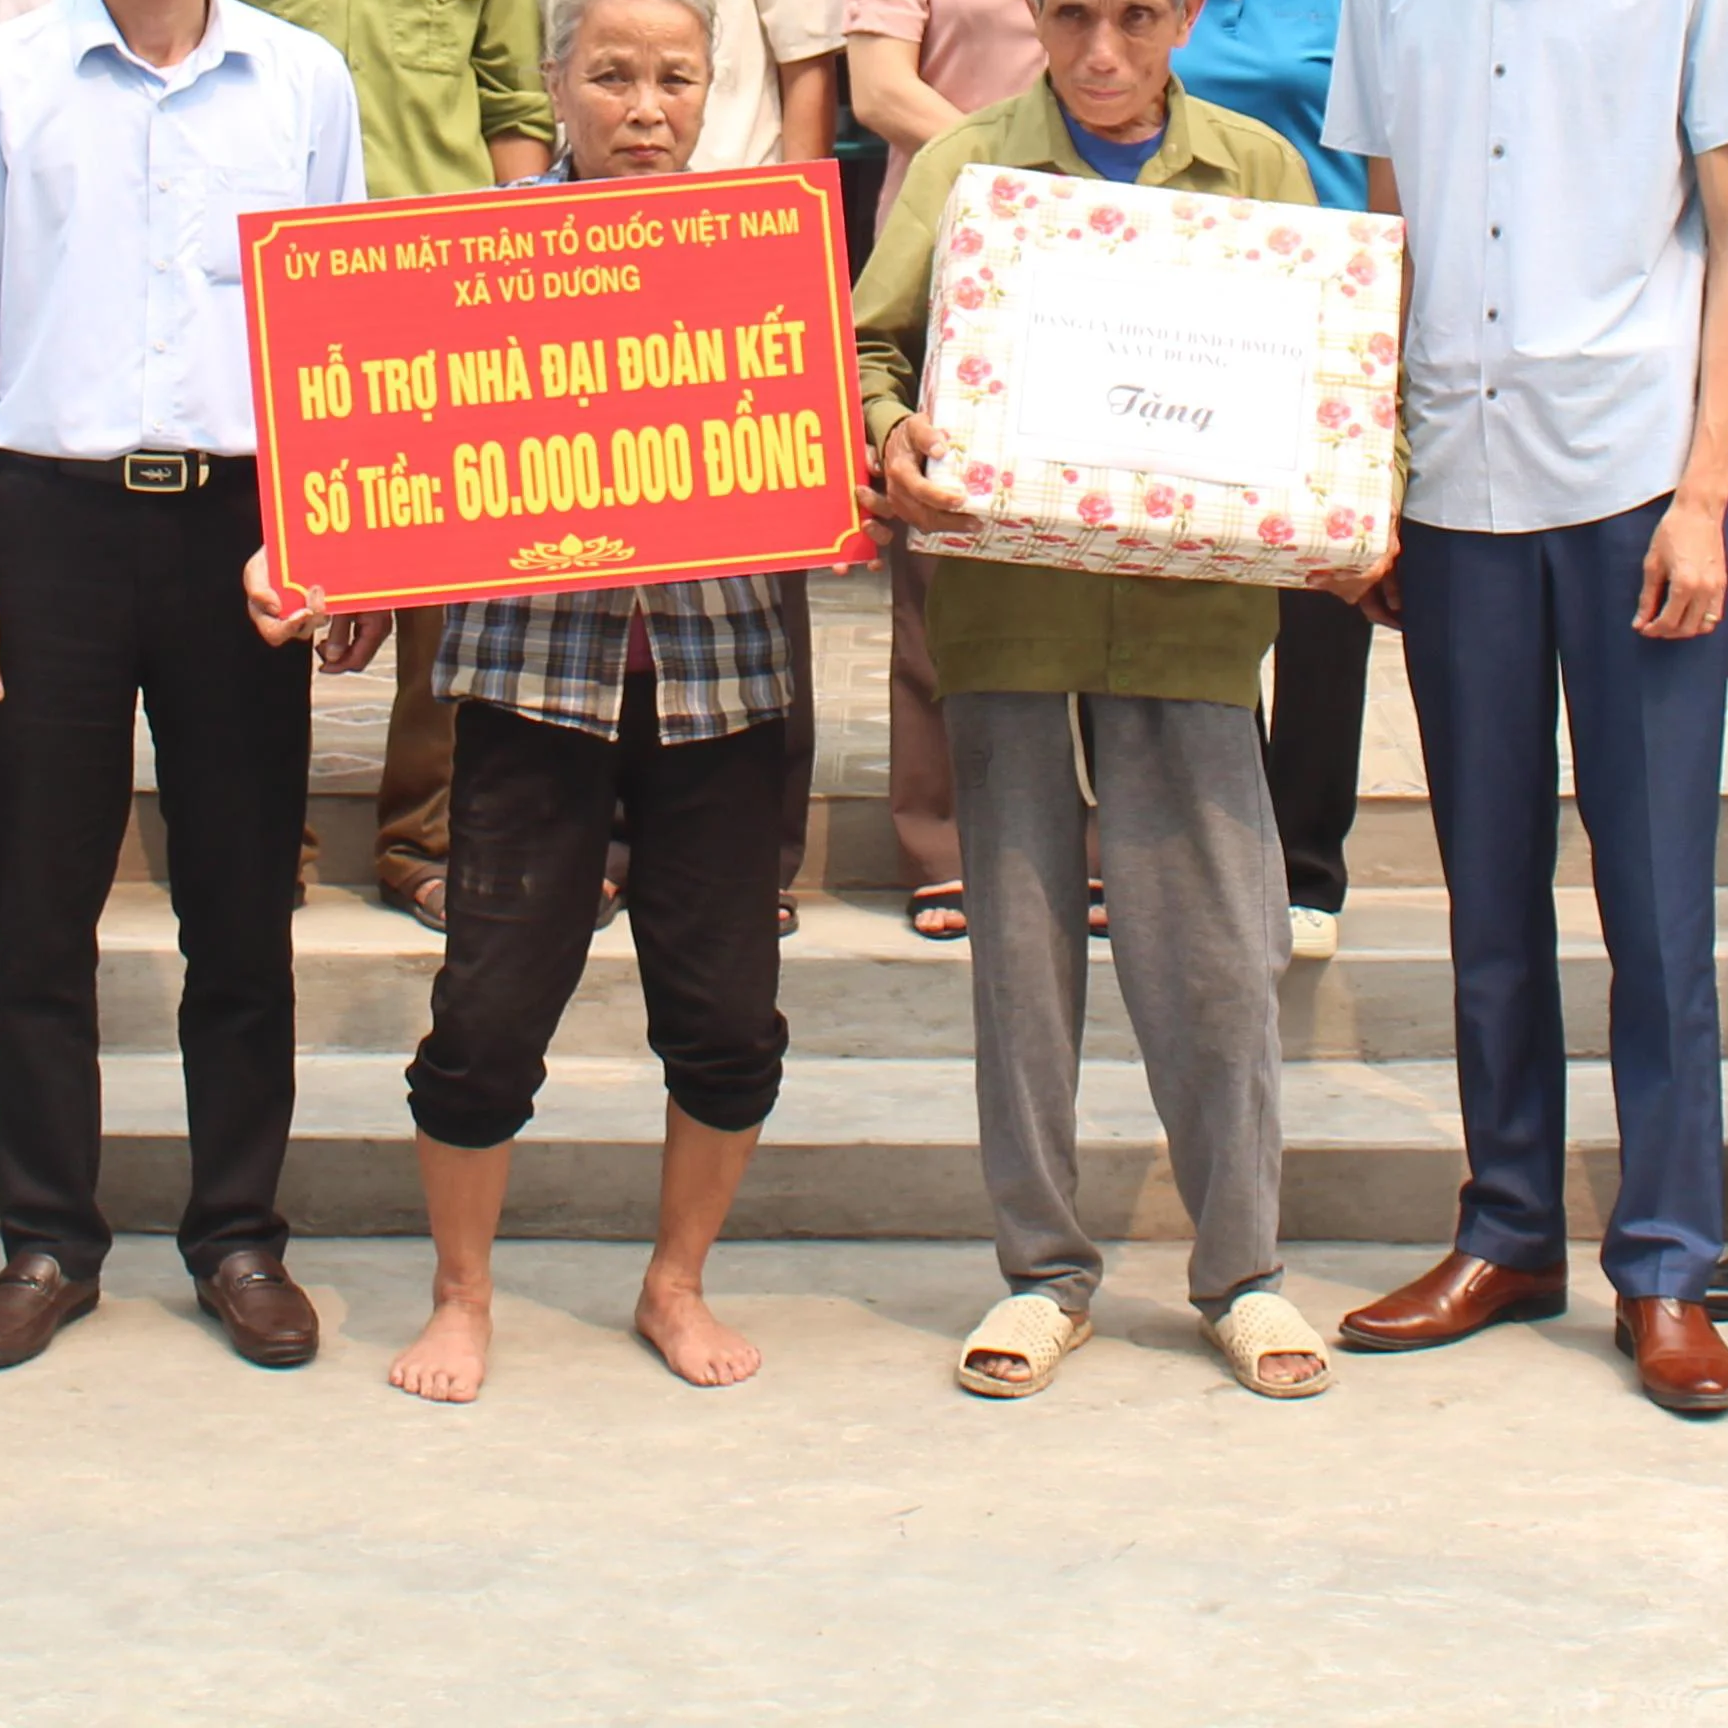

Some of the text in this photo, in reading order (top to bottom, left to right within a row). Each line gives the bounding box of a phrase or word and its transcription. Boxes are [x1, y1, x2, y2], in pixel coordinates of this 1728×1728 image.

[285, 208, 799, 280] ỦY BAN MẶT TRẬN TỔ QUỐC VIỆT NAM
[454, 264, 640, 306] XÃ VŨ DƯƠNG
[298, 304, 805, 422] HỖ TRỢ NHÀ ĐẠI ĐOÀN KẾT
[1106, 384, 1215, 432] Tặng
[304, 389, 826, 535] Số Tiền: 60.000.000 ĐỒNG
